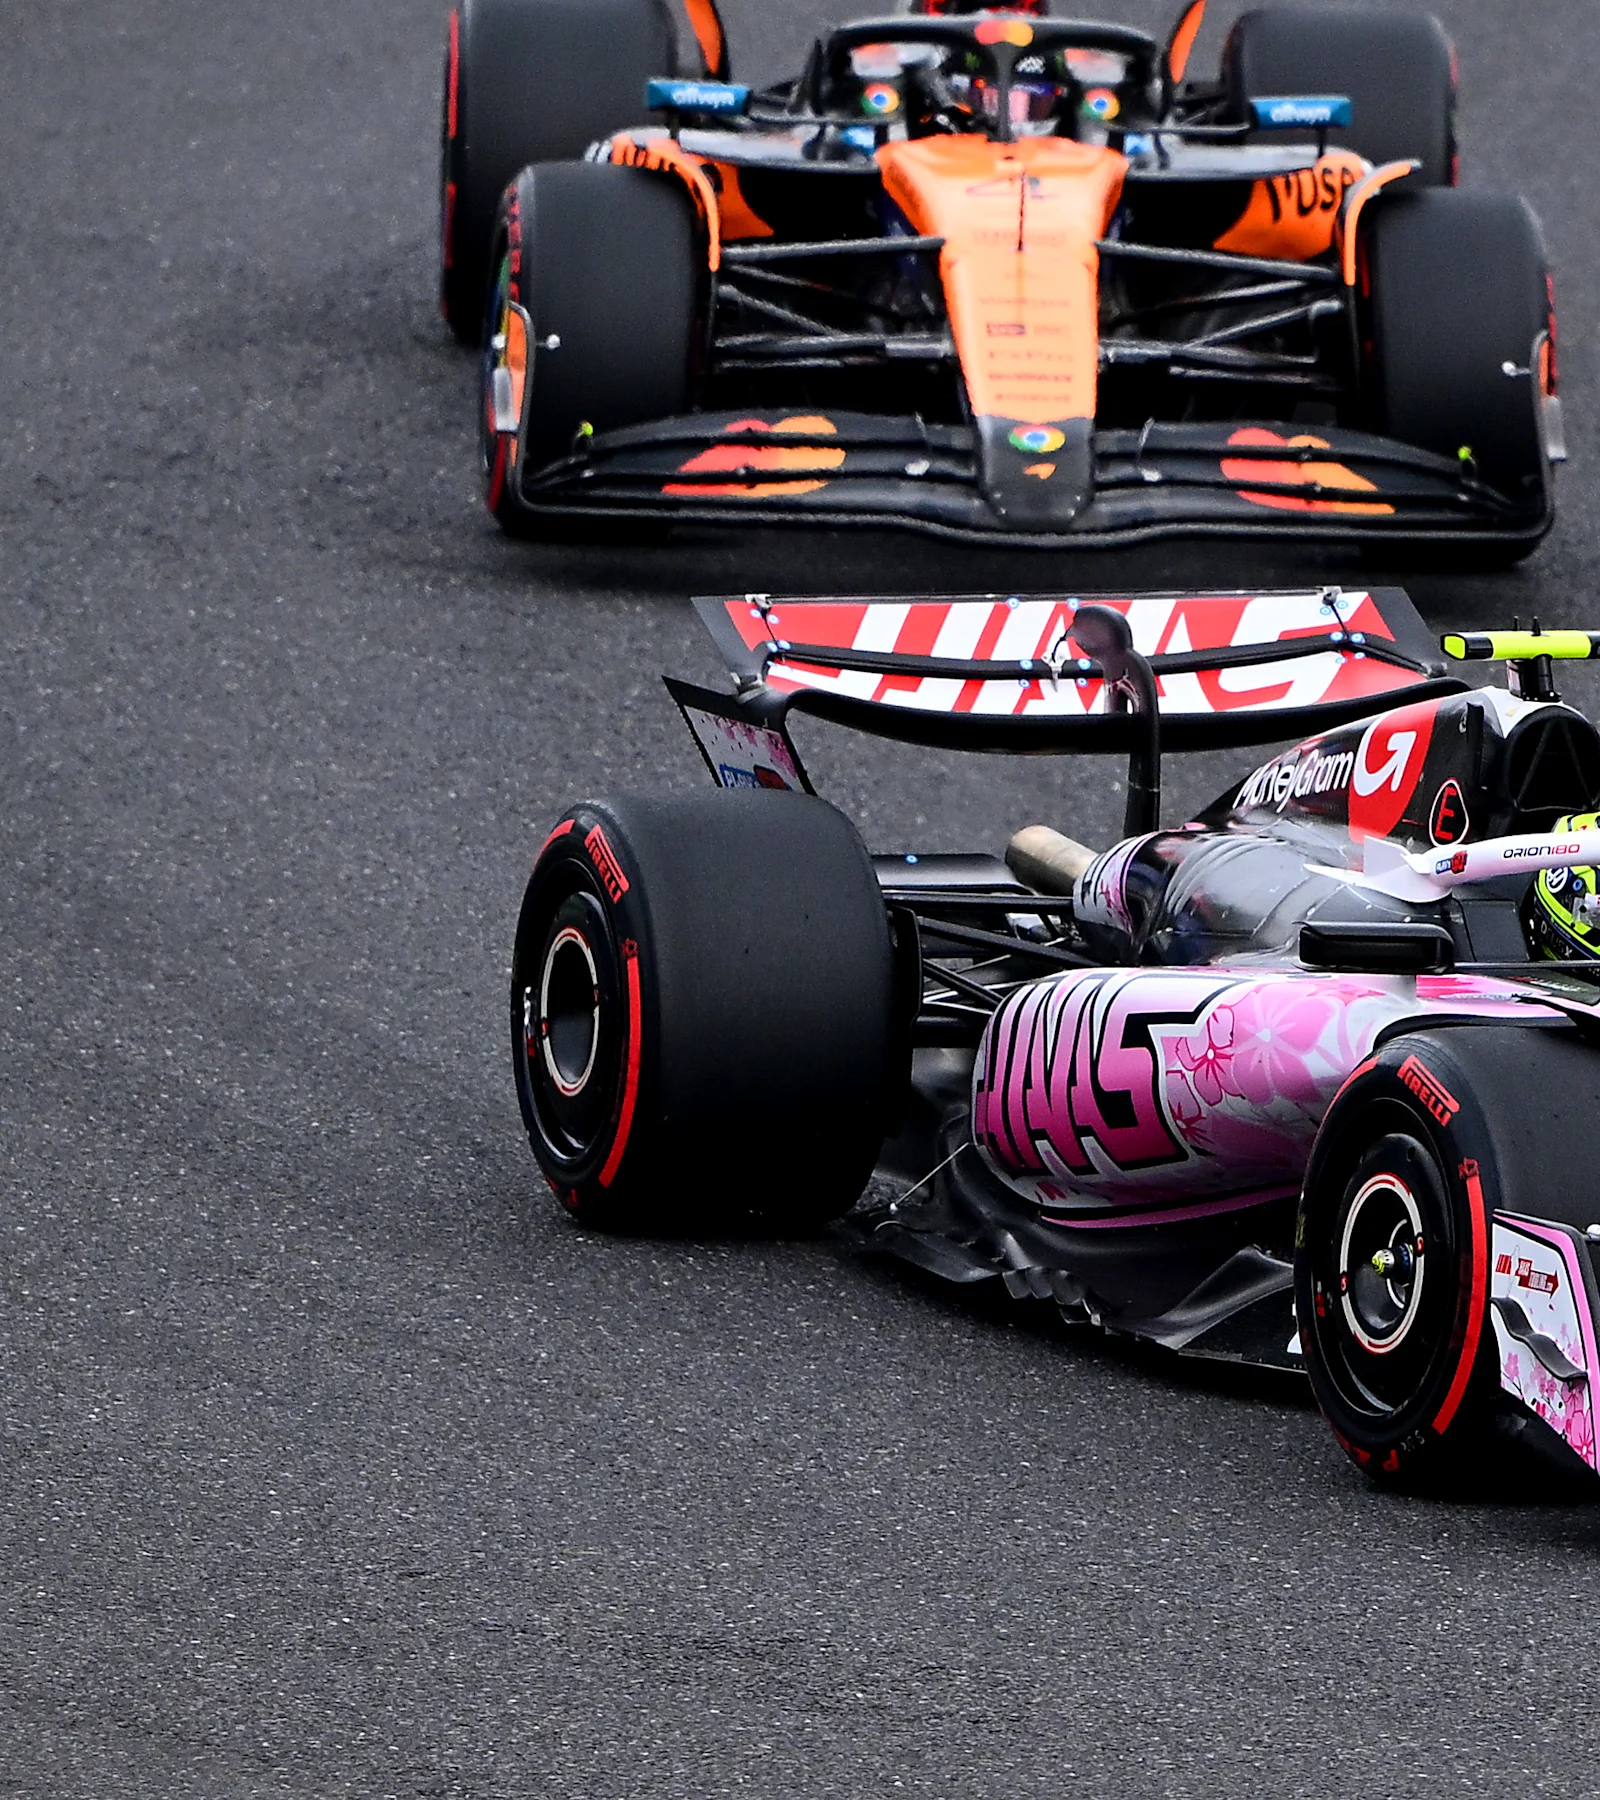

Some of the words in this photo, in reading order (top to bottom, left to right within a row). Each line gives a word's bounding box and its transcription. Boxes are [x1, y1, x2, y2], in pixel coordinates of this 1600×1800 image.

[1232, 749, 1355, 814] MoneyGram
[1435, 786, 1458, 841] E
[584, 823, 631, 905] PIRELLI
[975, 973, 1252, 1176] HAAS
[1396, 1054, 1461, 1127] PIRELLI
